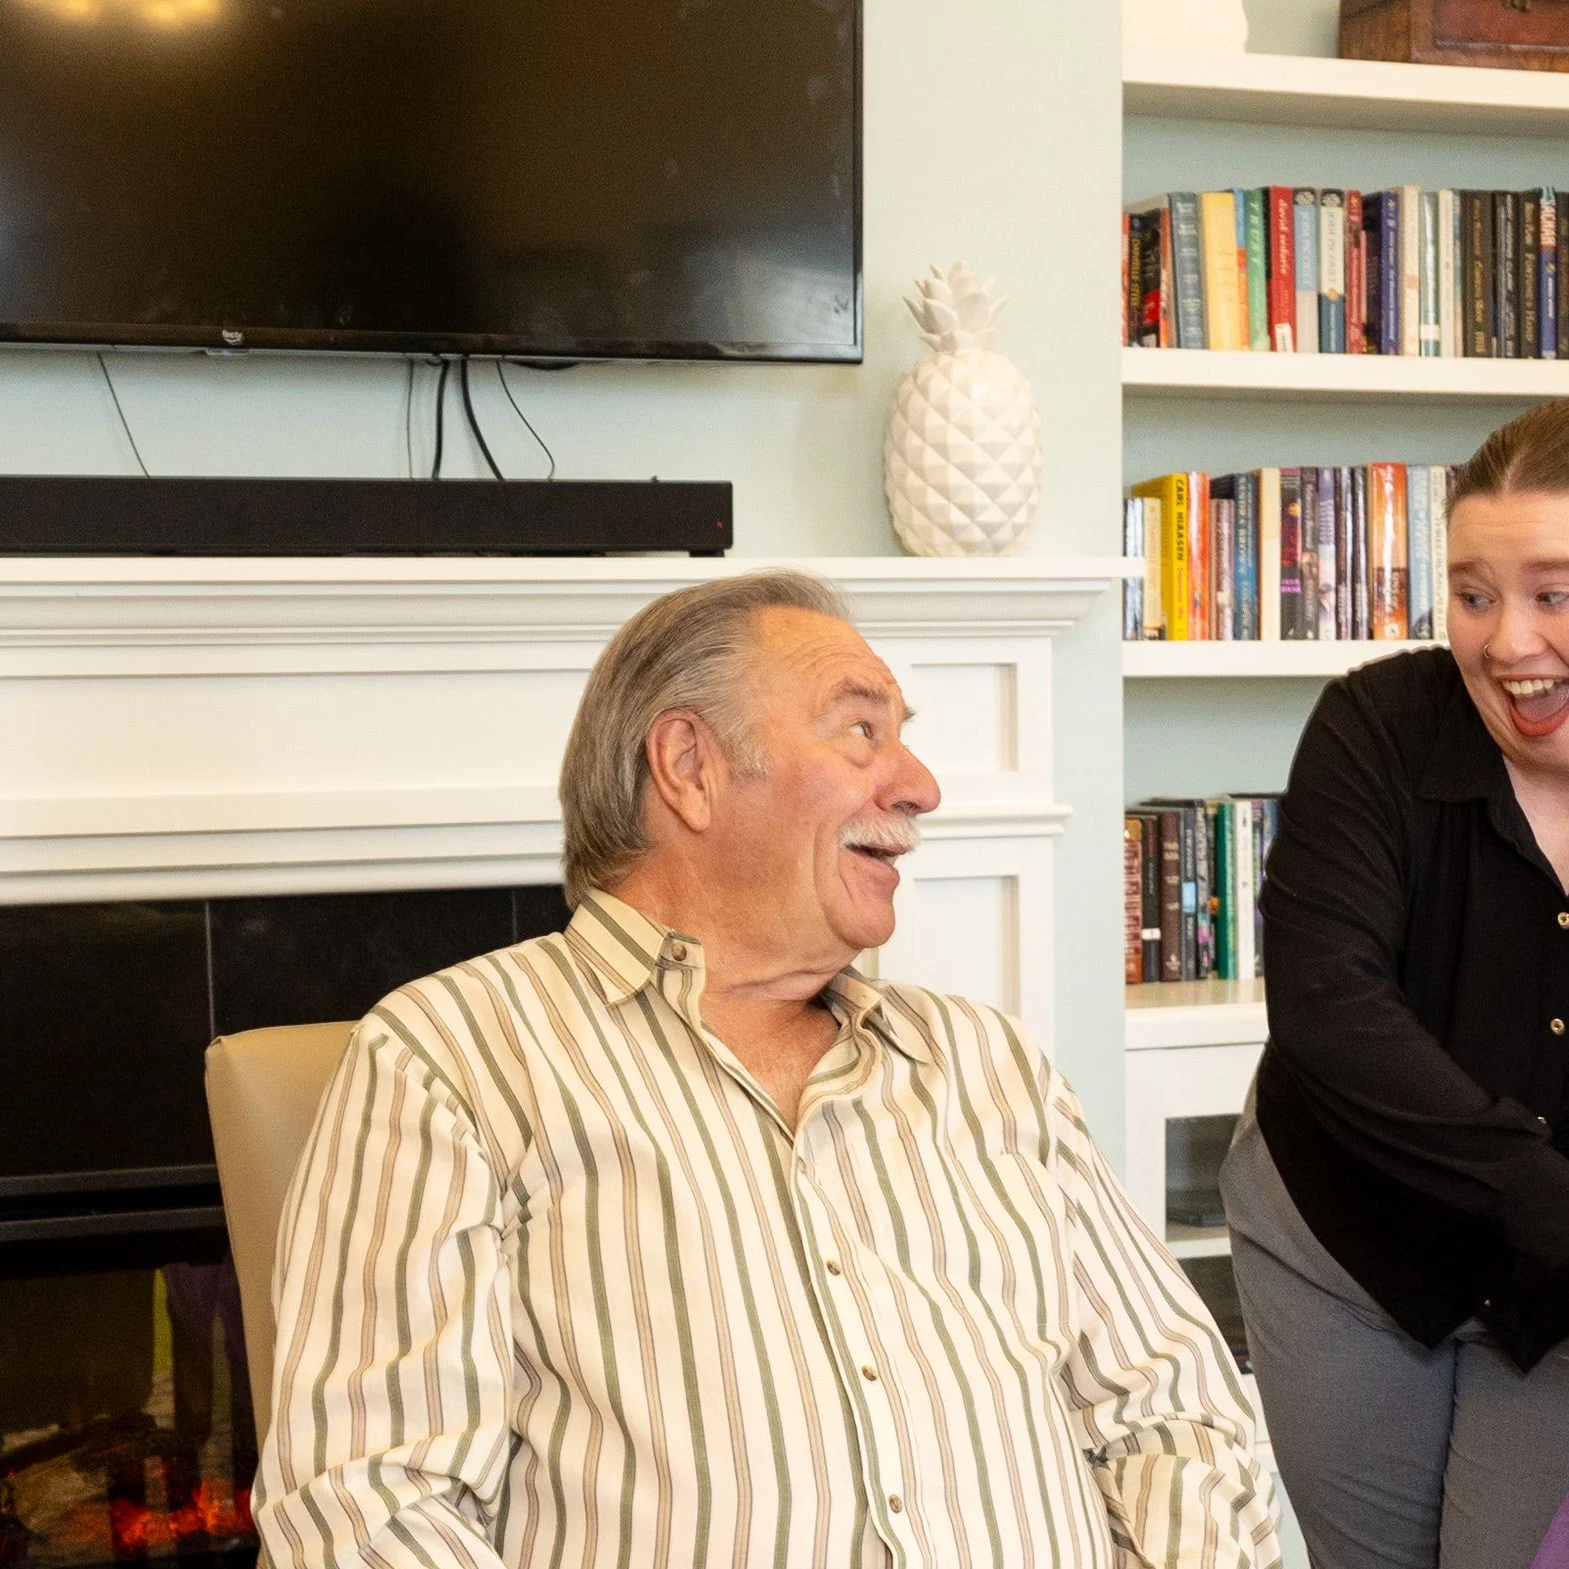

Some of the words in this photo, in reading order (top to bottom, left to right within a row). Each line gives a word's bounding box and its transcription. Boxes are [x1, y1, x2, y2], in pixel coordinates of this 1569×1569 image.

[1278, 199, 1289, 232] david
[1279, 234, 1290, 275] sedaris
[1327, 237, 1336, 284] PICOULT
[1176, 479, 1184, 507] CARL
[1238, 529, 1247, 575] BROWN
